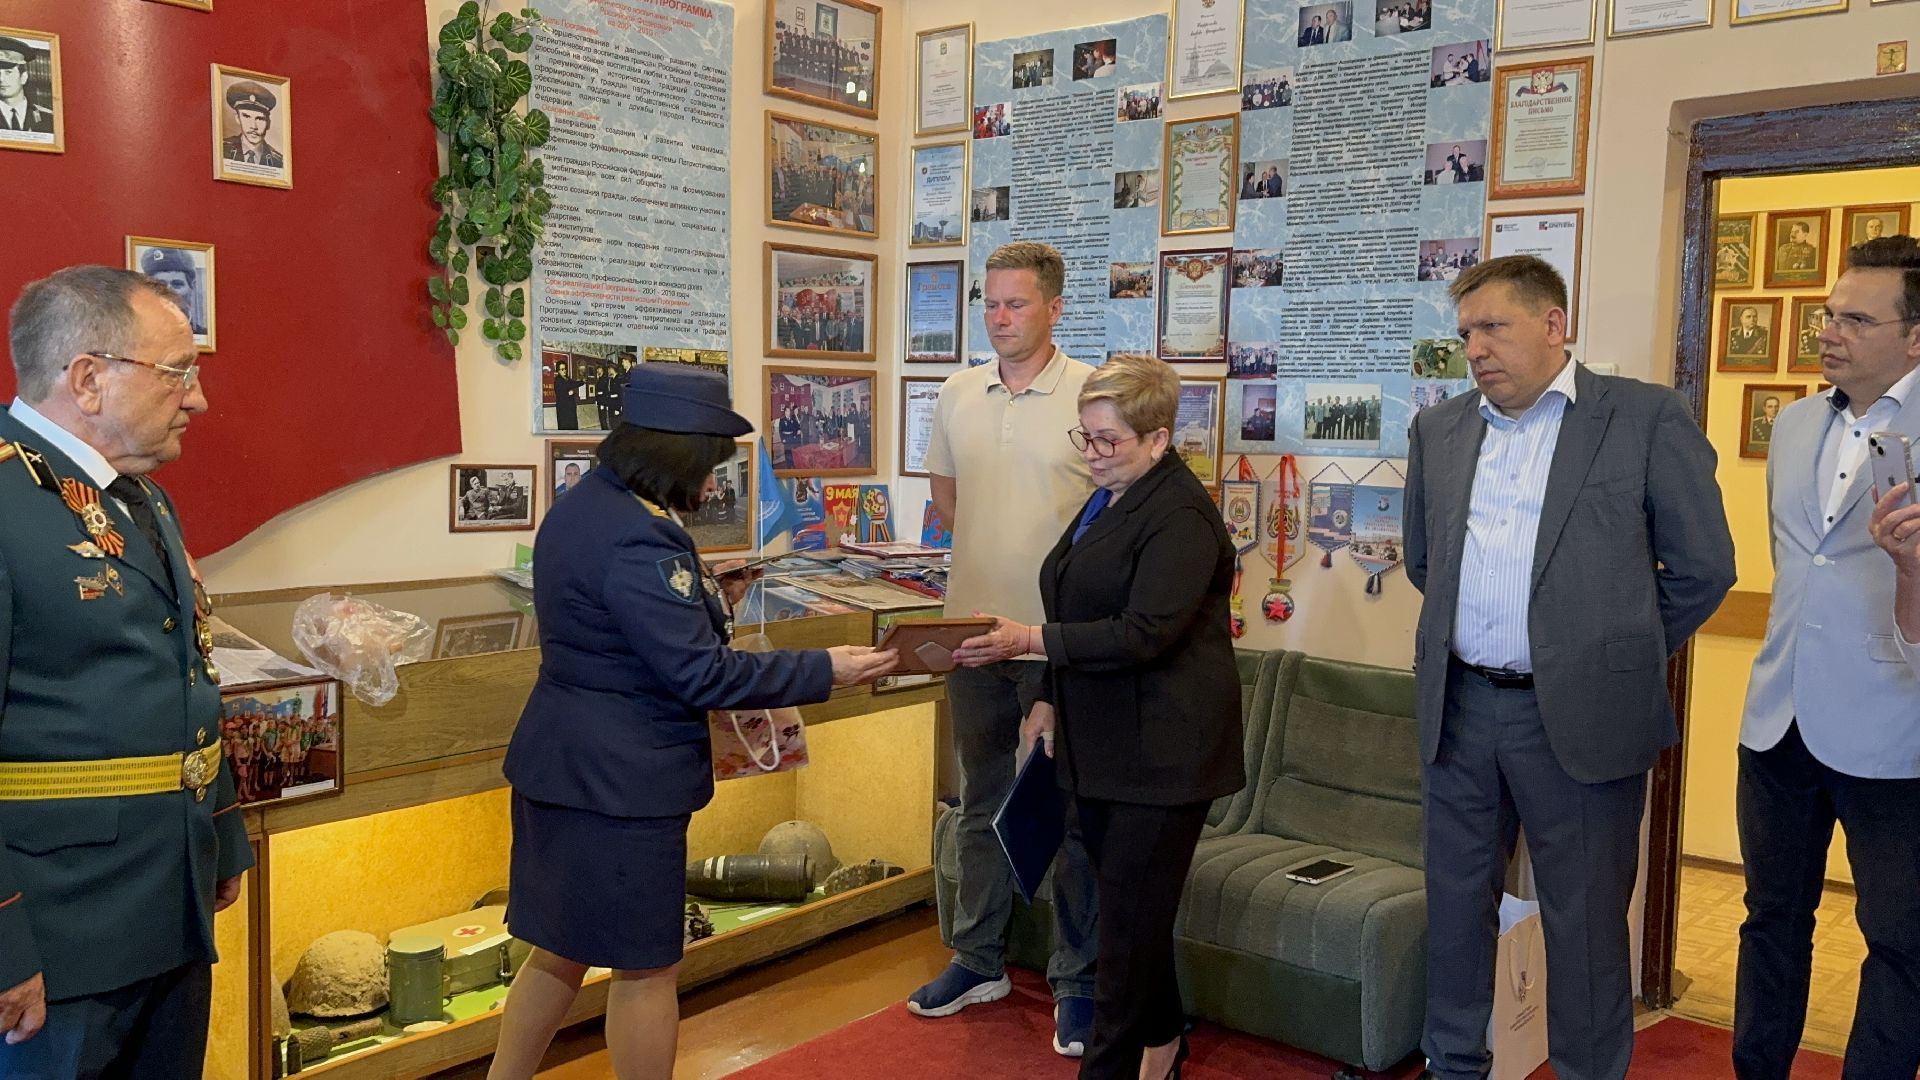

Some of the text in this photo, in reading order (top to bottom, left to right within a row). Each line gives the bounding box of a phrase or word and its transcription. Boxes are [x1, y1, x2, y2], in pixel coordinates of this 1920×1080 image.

[534, 42, 570, 57] способной
[572, 52, 580, 60] на
[606, 238, 622, 246] норм
[826, 486, 860, 501] 9 МАЯ
